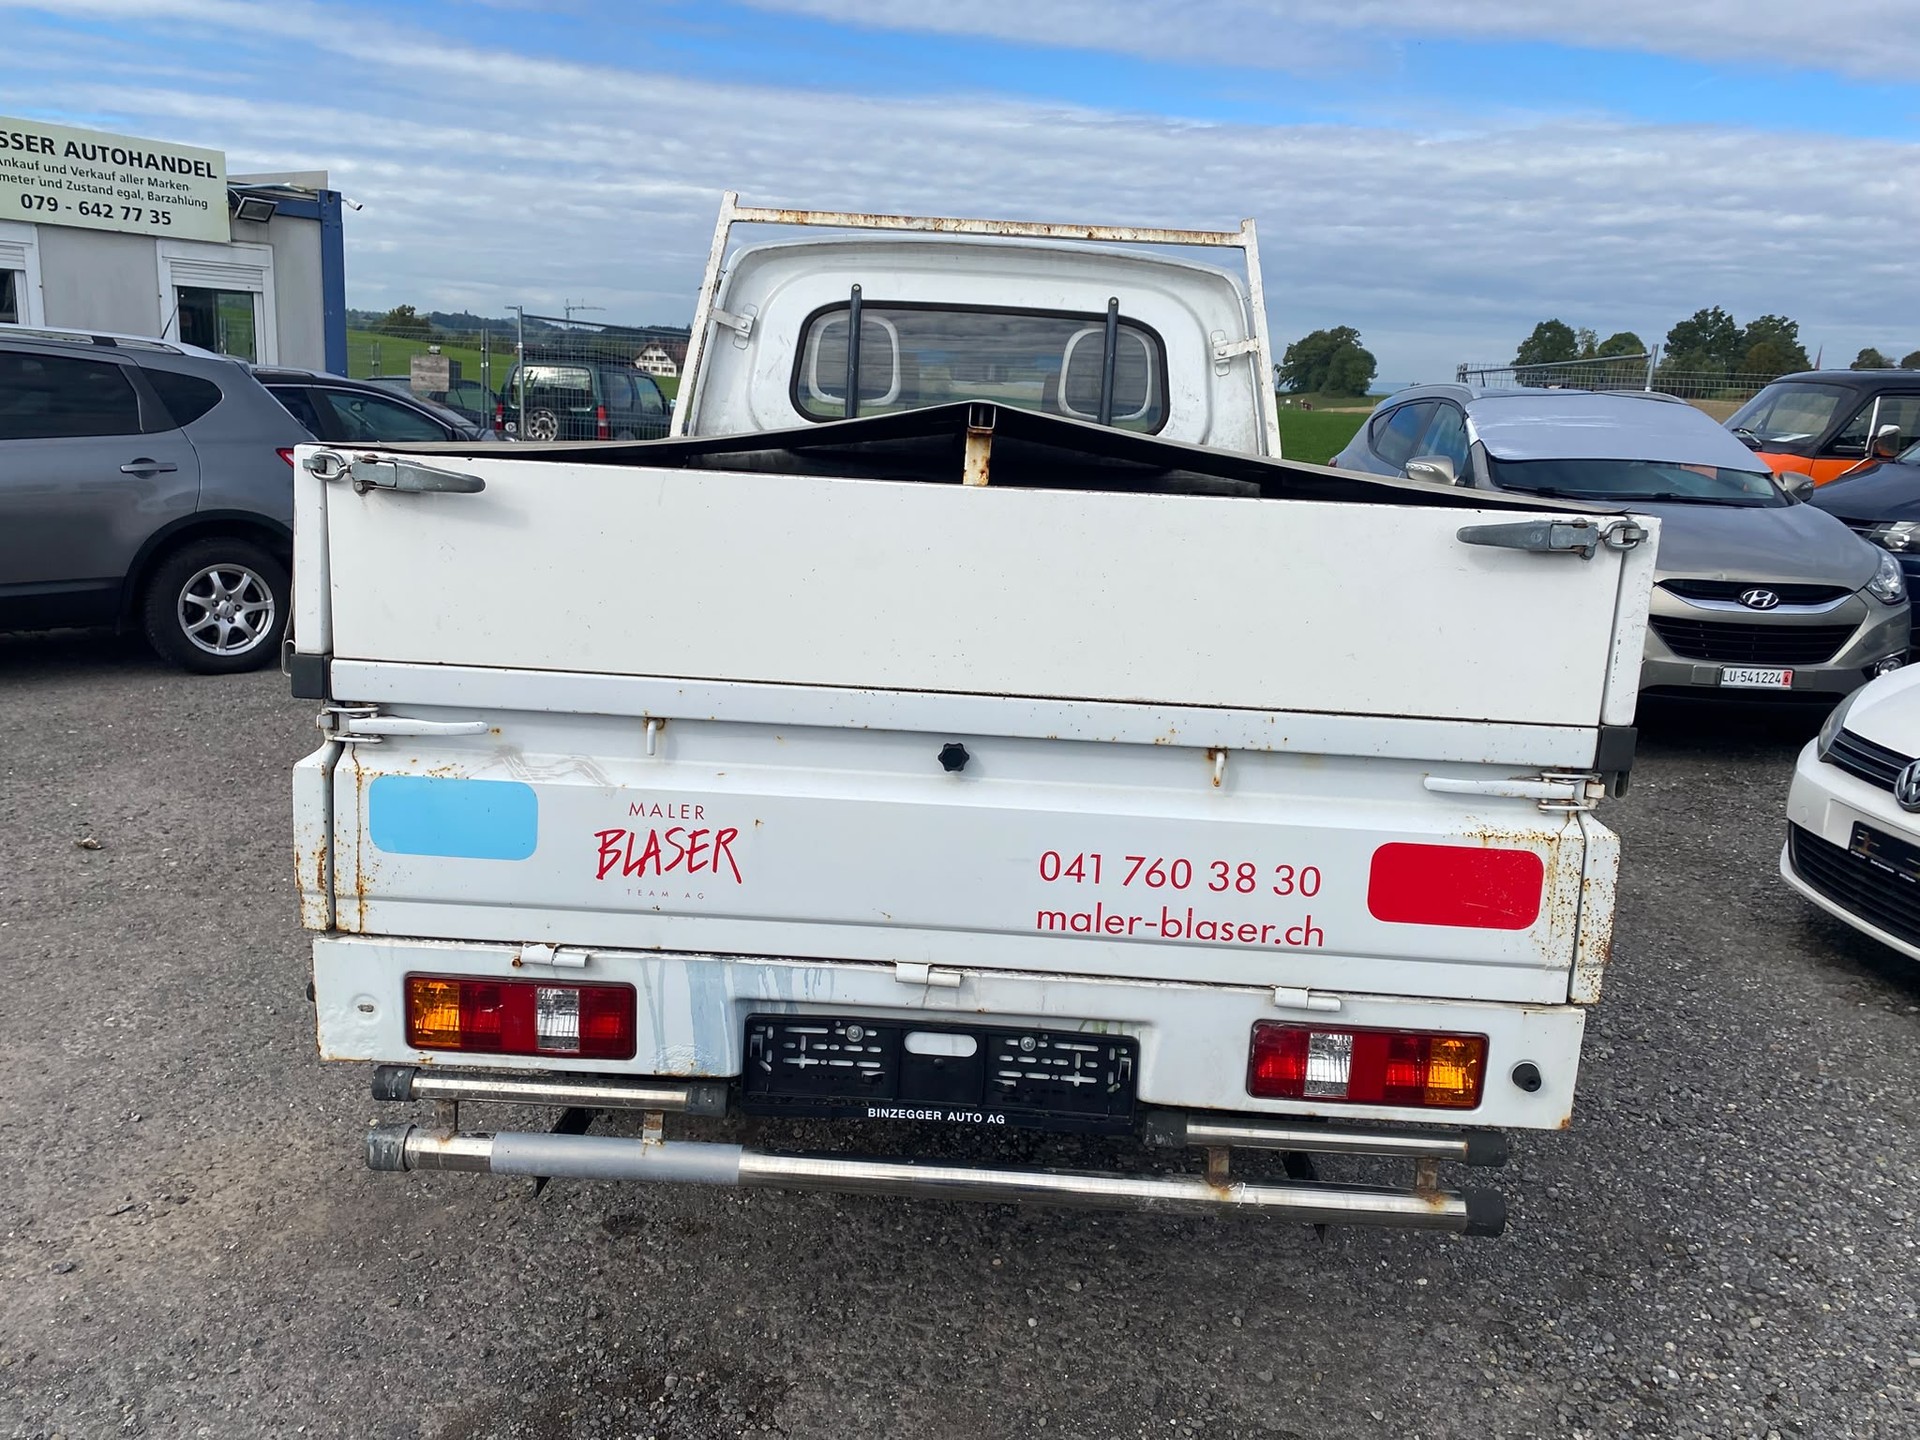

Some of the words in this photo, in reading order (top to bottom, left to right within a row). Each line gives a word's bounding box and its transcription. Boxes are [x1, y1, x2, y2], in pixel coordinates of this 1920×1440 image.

[43, 164, 67, 175] und
[70, 166, 116, 181] Verkauf
[119, 173, 144, 186] aller
[64, 141, 218, 179] AUTOHANDEL
[20, 193, 58, 212] 079
[78, 200, 114, 219] 642
[120, 205, 142, 222] 77
[149, 209, 172, 225] 35
[39, 178, 63, 189] und
[66, 180, 113, 196] Zustand
[117, 188, 144, 201] egal,
[147, 191, 208, 211] Barzahlung
[628, 801, 705, 820] MALER
[594, 826, 742, 884] BLASER
[1039, 850, 1101, 885] 041
[1122, 855, 1192, 890] 760
[1208, 860, 1257, 894] 38
[1272, 864, 1322, 897] 30
[627, 888, 669, 897] TEAM
[684, 892, 705, 900] AG
[1036, 902, 1324, 947] maler-blaser.ch
[867, 1107, 942, 1120] BINZEGGER
[947, 1111, 982, 1123] AUTO
[986, 1114, 1005, 1124] AG
